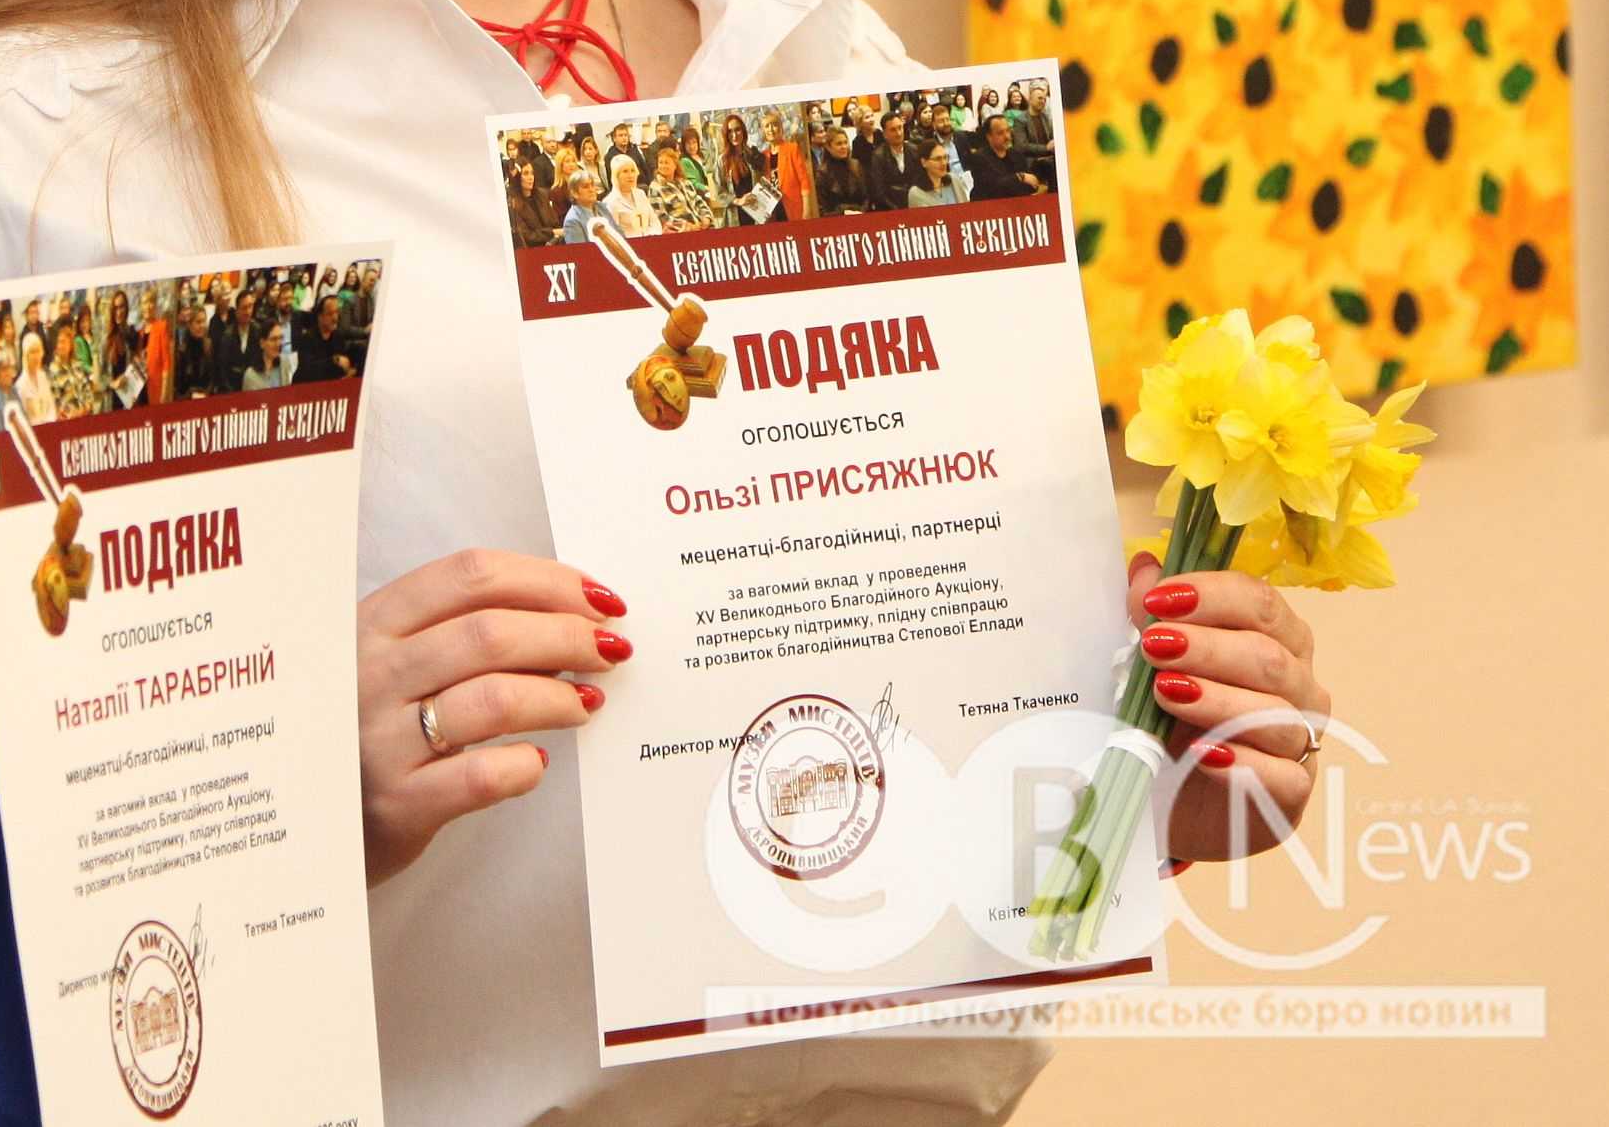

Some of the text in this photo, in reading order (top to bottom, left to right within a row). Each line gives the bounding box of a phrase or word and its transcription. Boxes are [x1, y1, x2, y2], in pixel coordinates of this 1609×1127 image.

[542, 262, 578, 302] XV
[732, 315, 940, 393] ПОДЯКА
[741, 411, 905, 445] оголошується
[665, 449, 999, 515] Ользі ПРИСЯЖНЮК
[99, 507, 243, 594] ПОДЯКА
[680, 511, 1002, 566] меценатці-благодійниці, партнерці
[695, 577, 1004, 626] XV Великоднього Благодійного Аукціону,
[728, 560, 967, 601] за вагомий вклад у проведення
[101, 612, 213, 652] оголошується
[684, 616, 1024, 669] та розвиток благодійництва Степової Еллади
[696, 597, 1009, 647] партнерську підтримку, плідну співпрацю
[55, 643, 275, 732] Наталії ТАРАБРІНІЙ
[958, 691, 1080, 718] Тетяна Ткаченко
[65, 717, 275, 786] меценатці-благодійниці, партнерці
[639, 736, 715, 761] Директор
[245, 906, 325, 939] Тетяна Ткаченко
